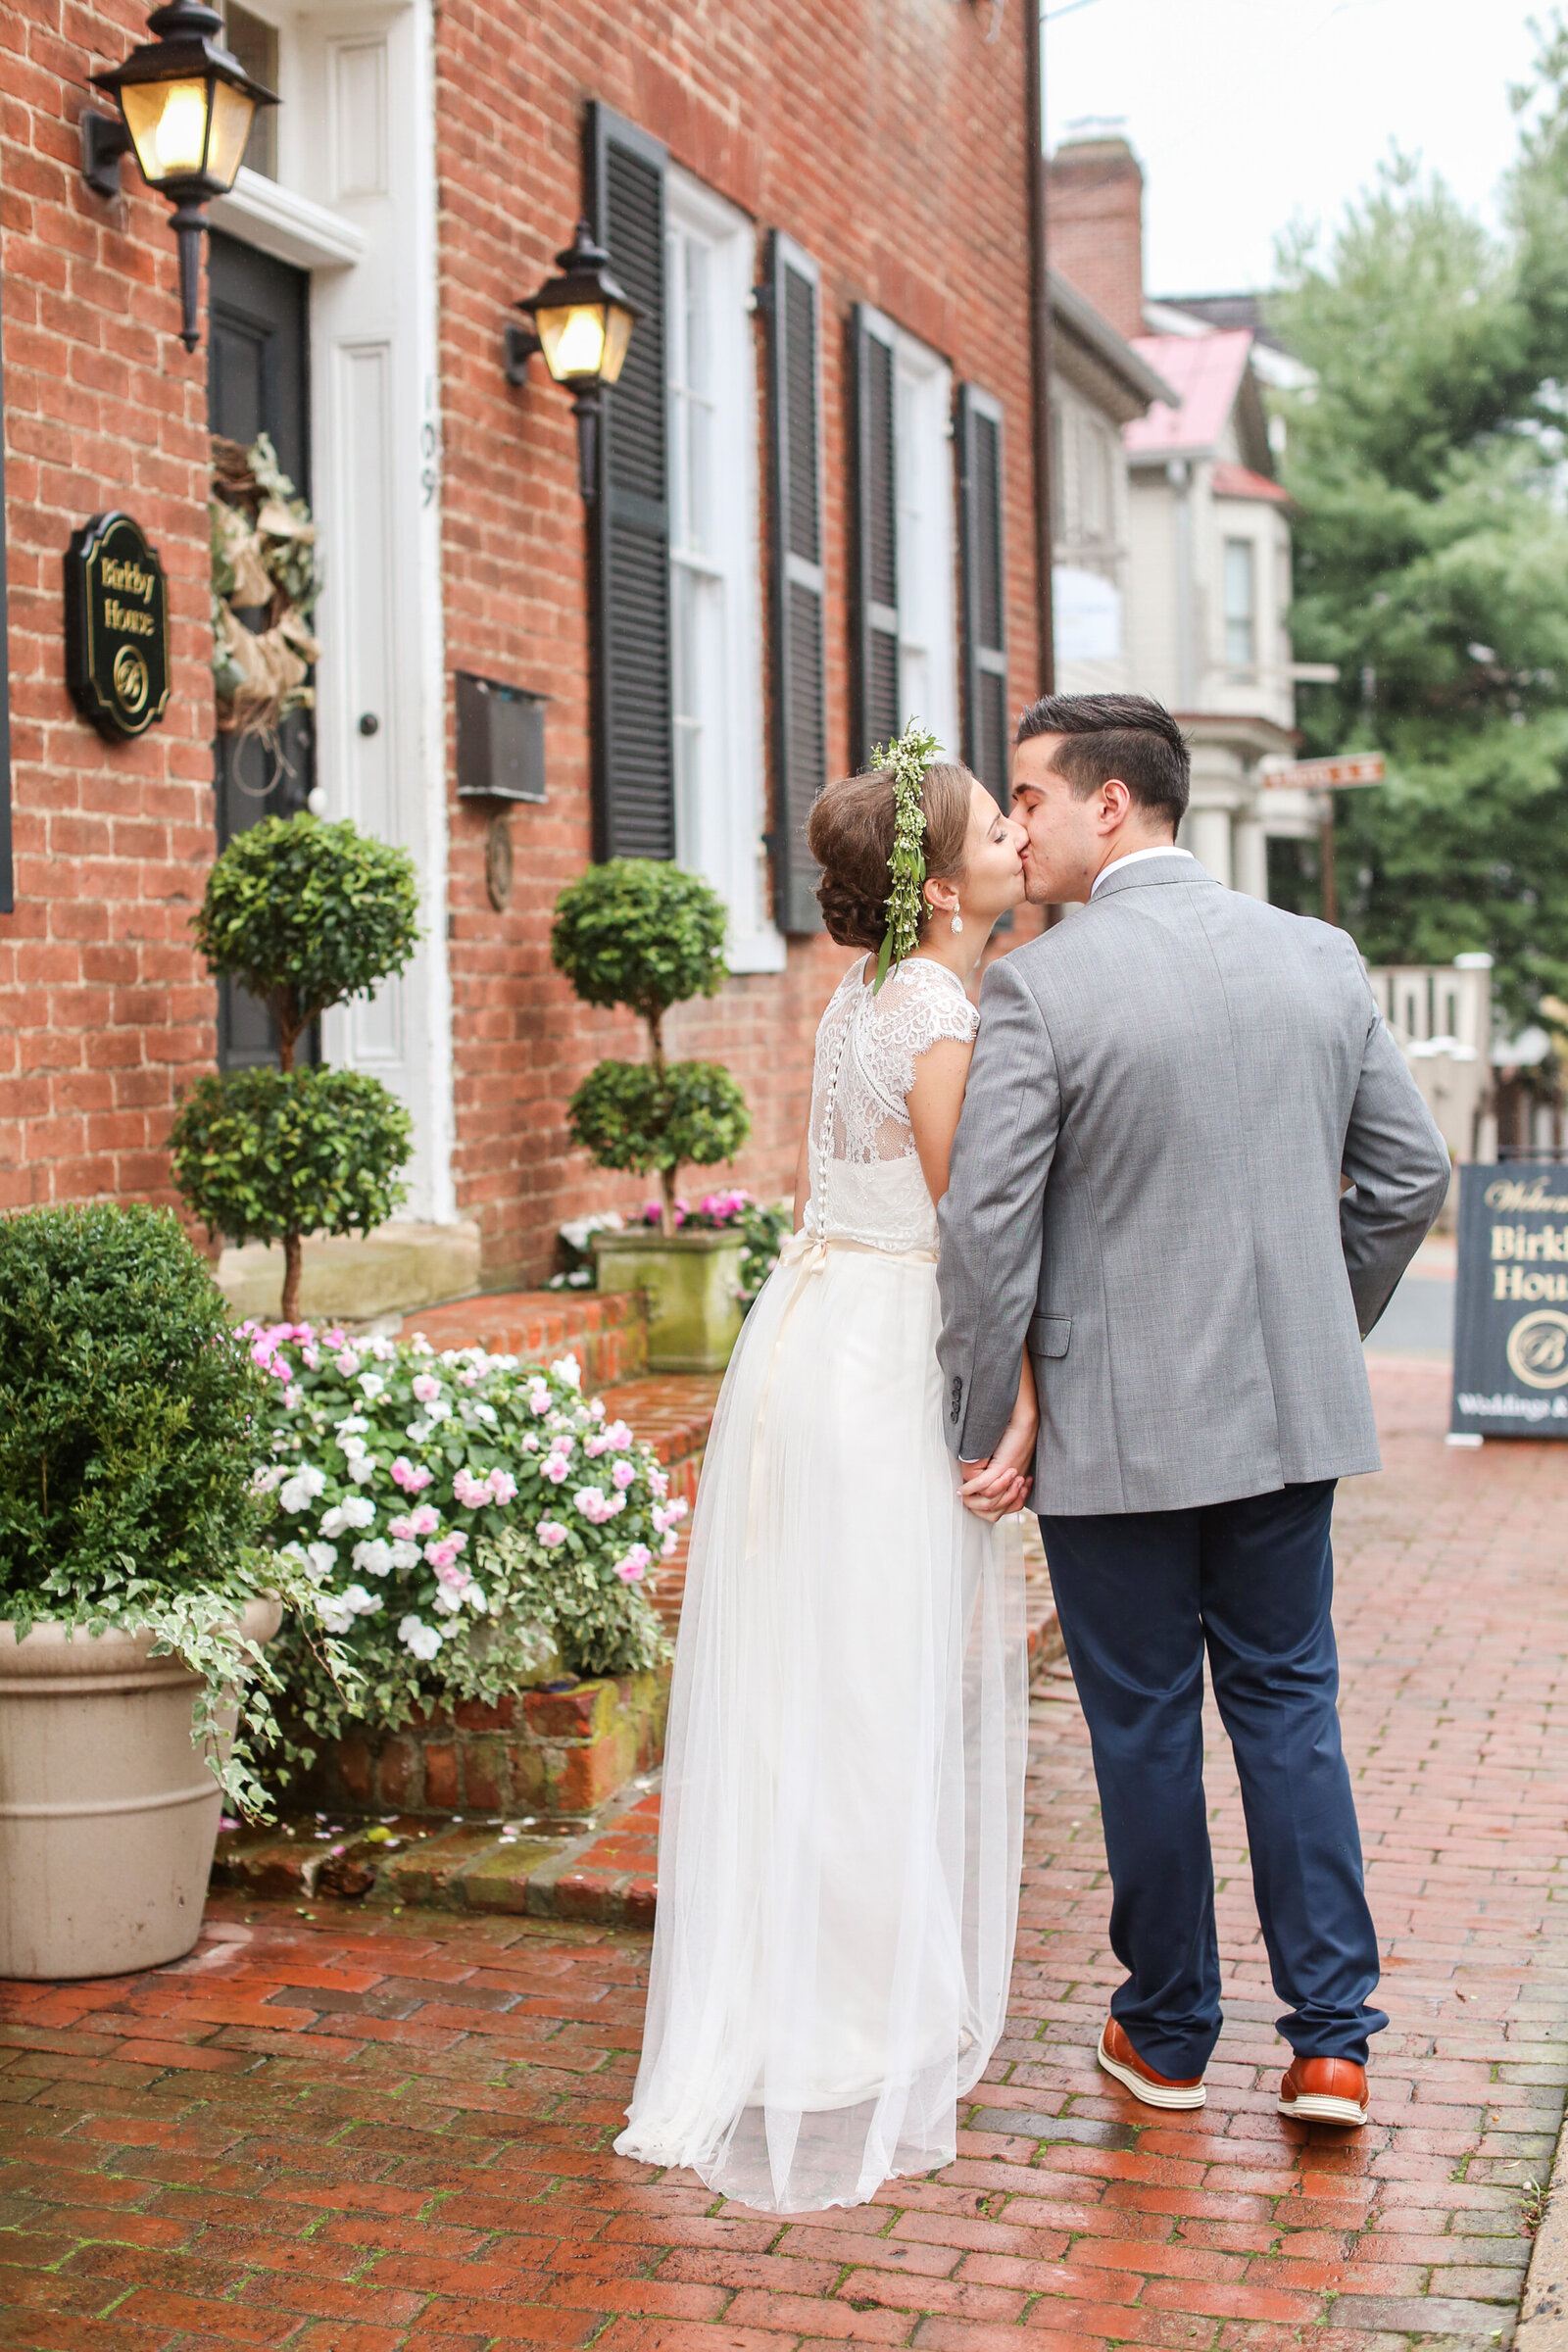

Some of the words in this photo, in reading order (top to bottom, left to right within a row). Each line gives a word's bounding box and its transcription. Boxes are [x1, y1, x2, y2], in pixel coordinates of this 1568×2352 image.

[420, 373, 435, 508] 109
[102, 557, 156, 605] Birkby
[104, 598, 155, 637] House
[1456, 1393, 1550, 1423] Weddings
